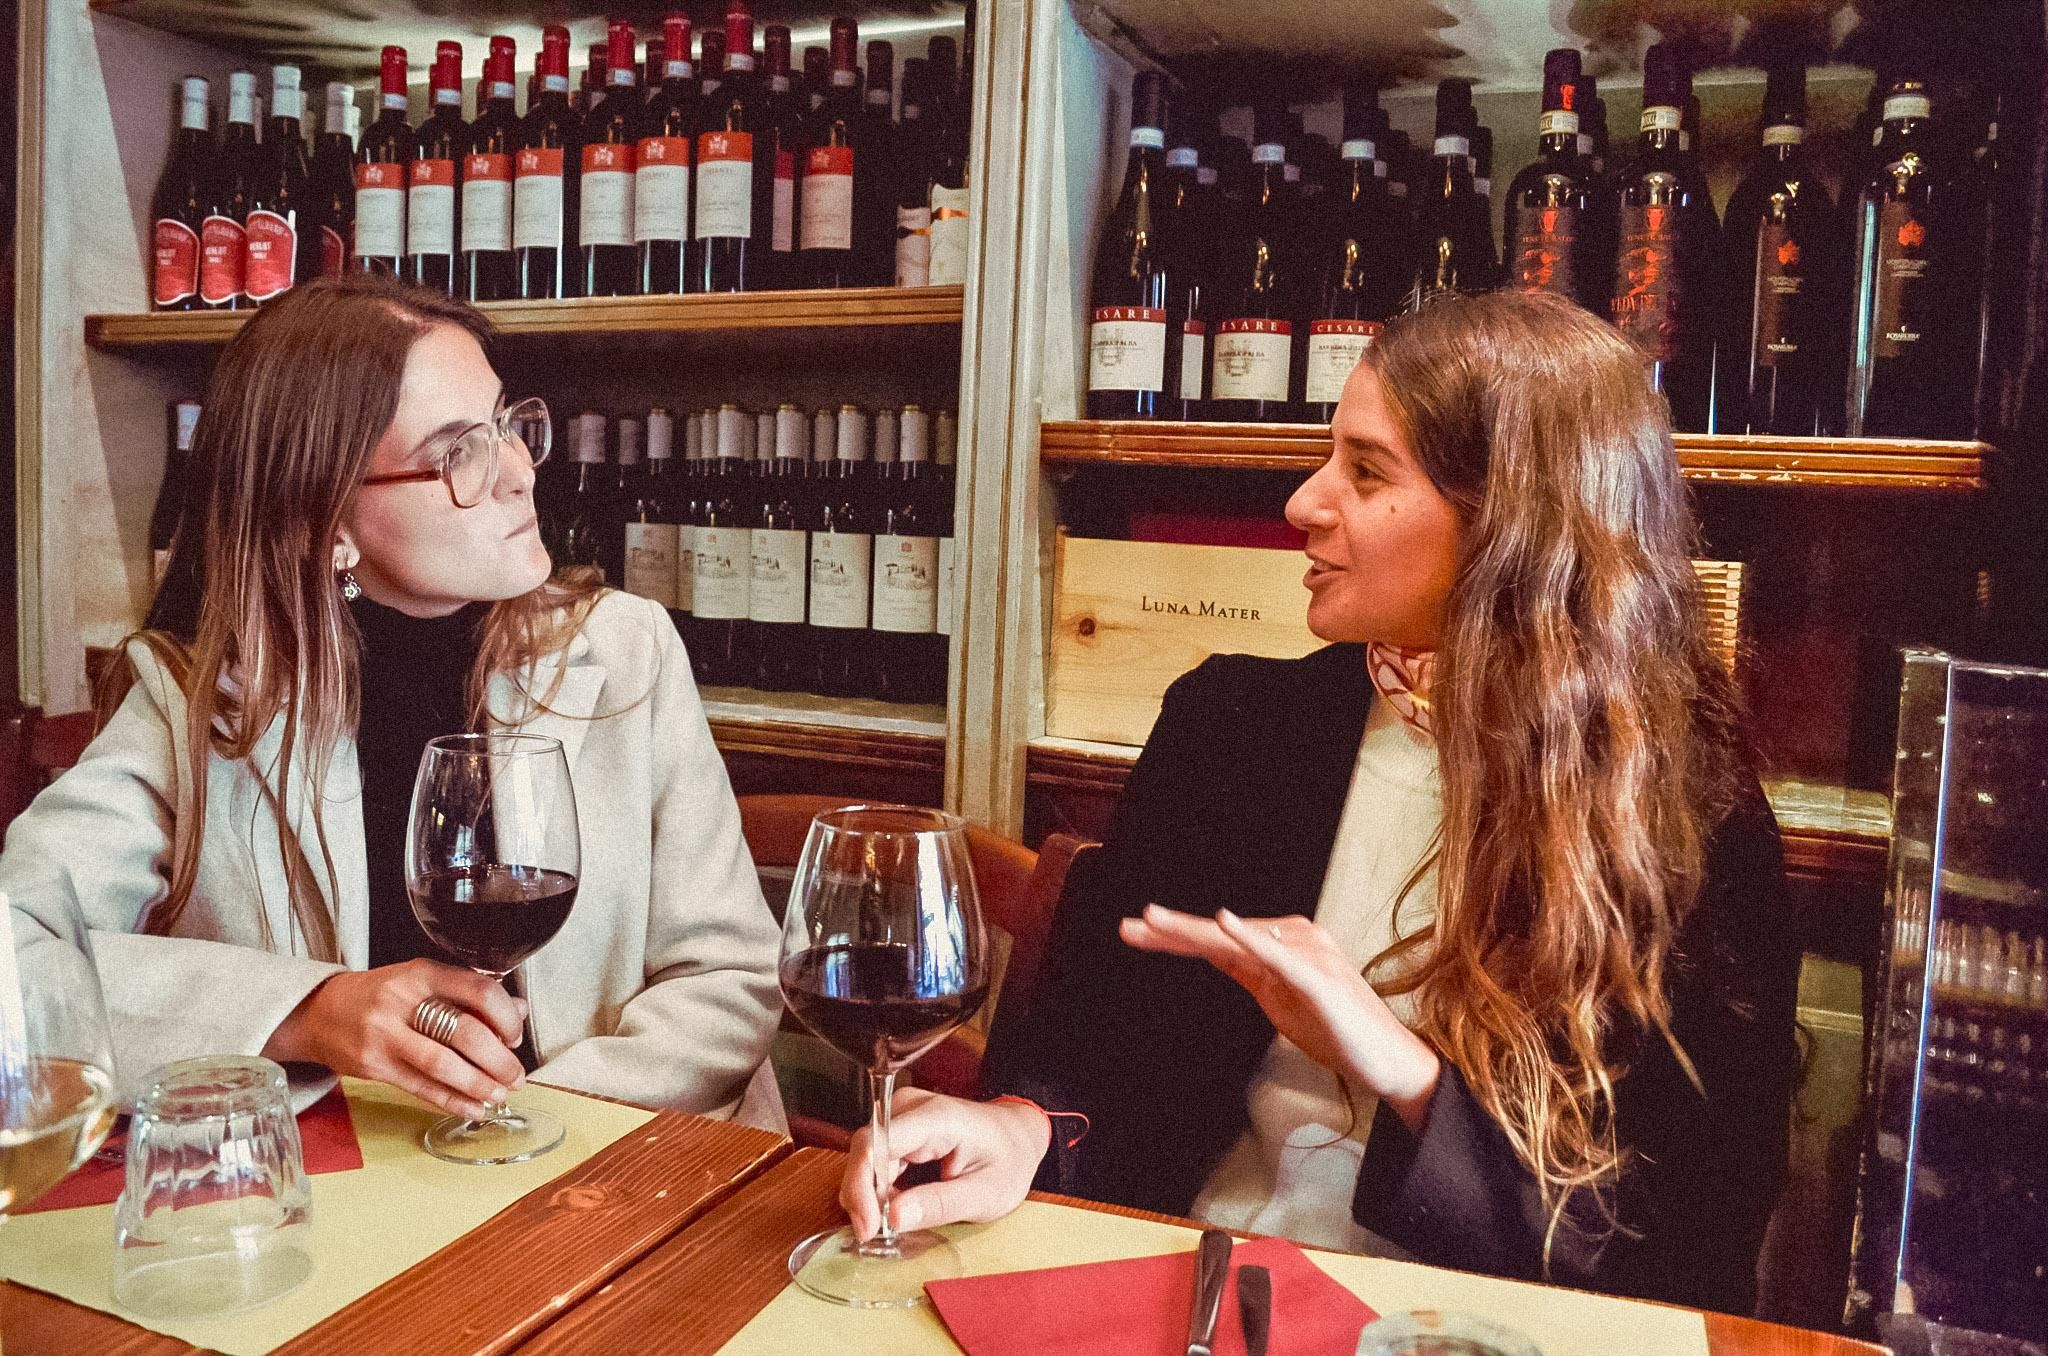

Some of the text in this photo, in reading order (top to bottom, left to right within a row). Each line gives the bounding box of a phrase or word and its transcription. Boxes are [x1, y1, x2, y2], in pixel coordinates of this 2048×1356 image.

[1095, 309, 1150, 320] ESARE
[1221, 321, 1278, 331] ESARE
[1316, 324, 1375, 334] CESARE
[1142, 595, 1261, 621] LUNA MATER
